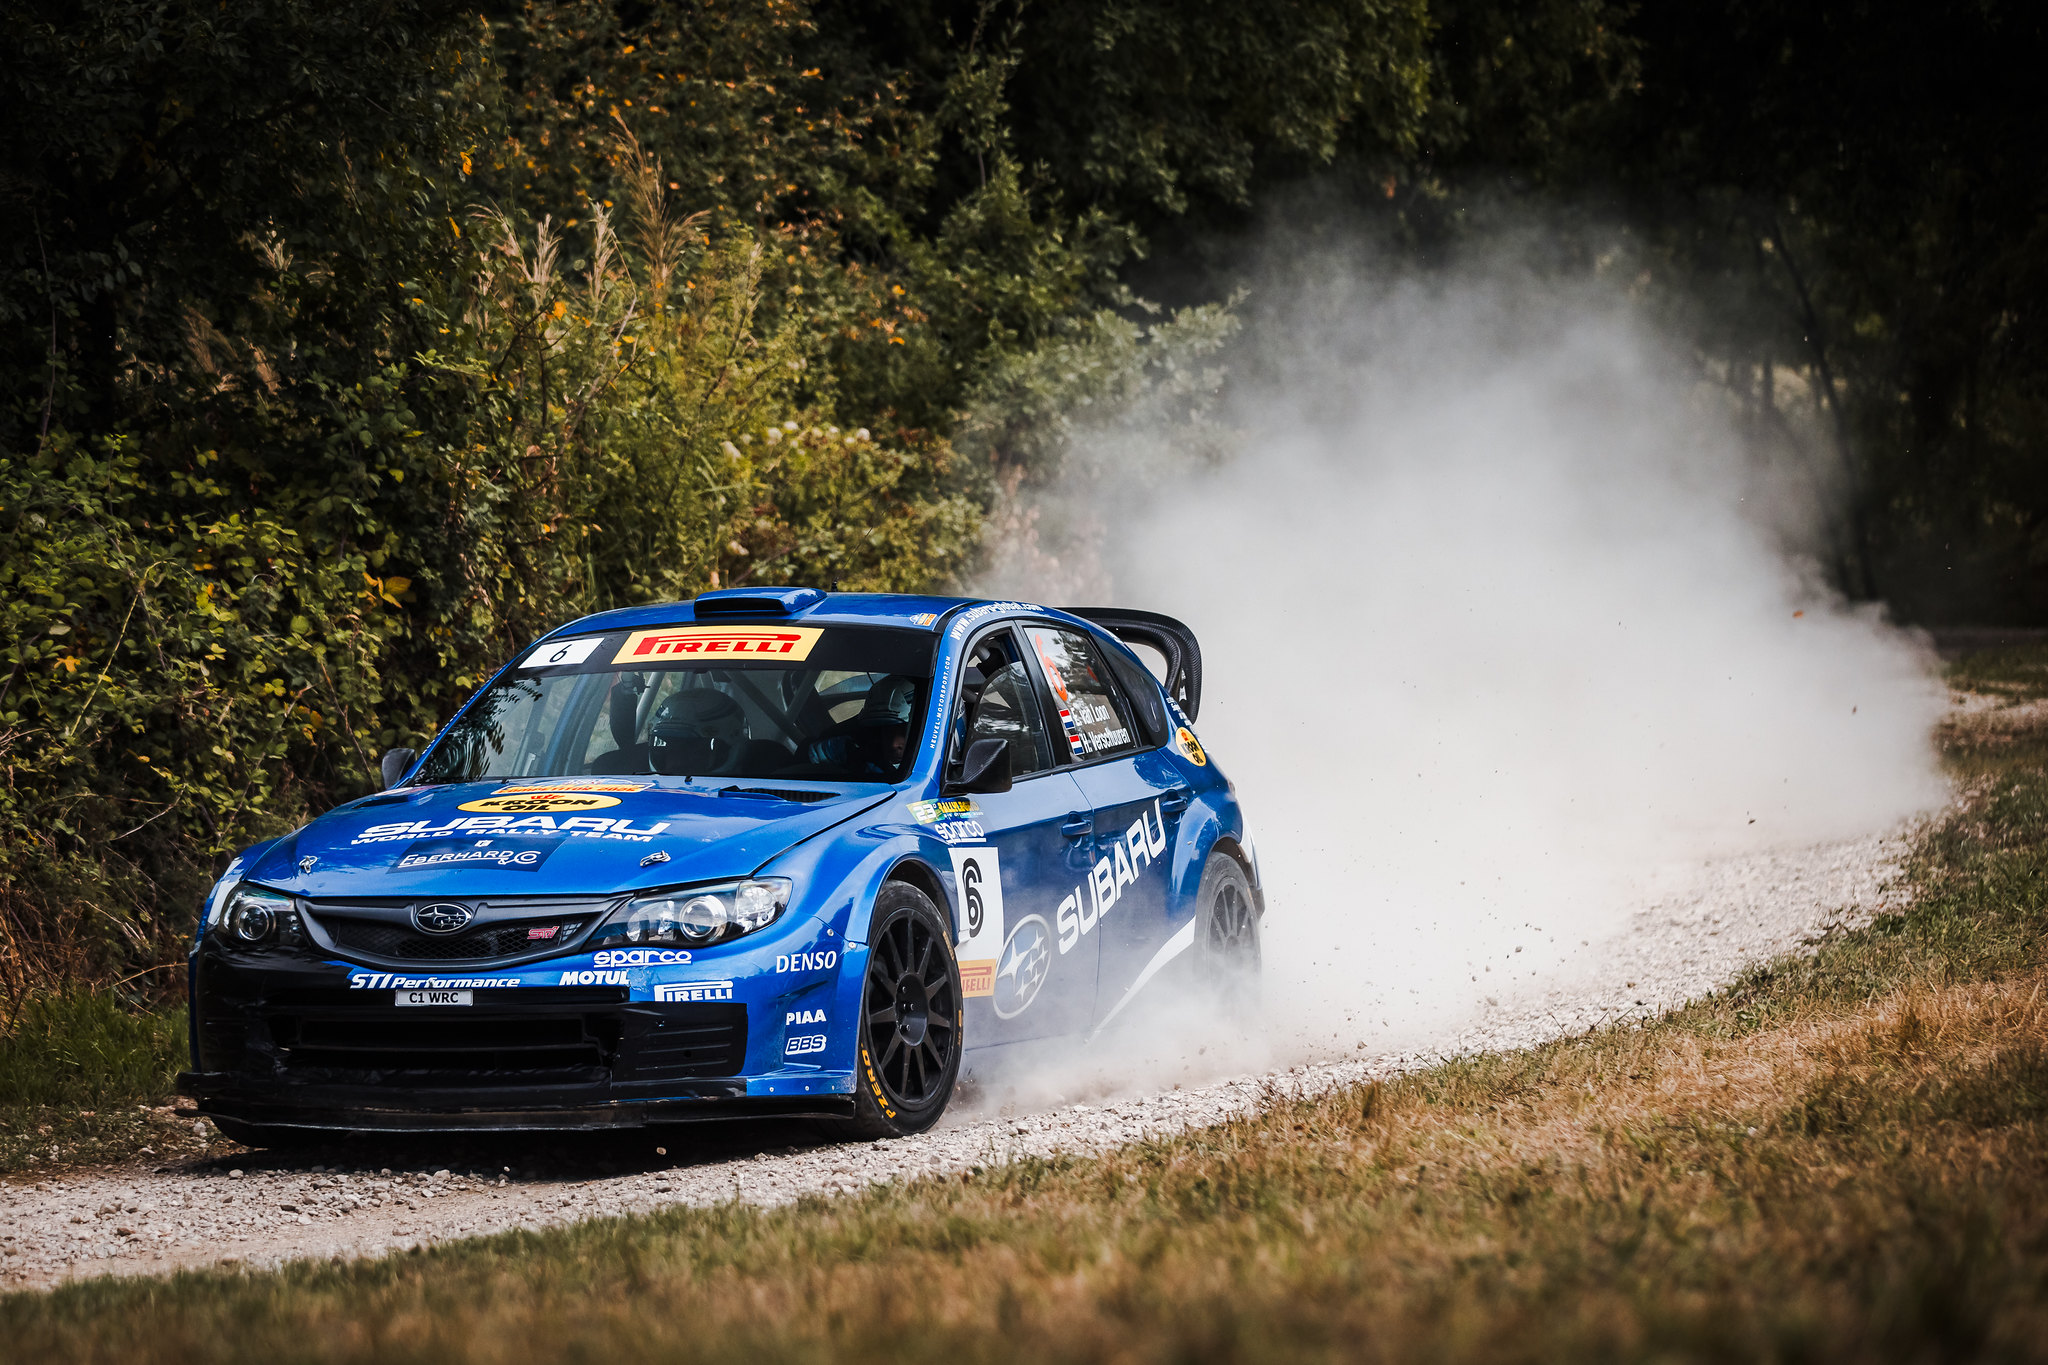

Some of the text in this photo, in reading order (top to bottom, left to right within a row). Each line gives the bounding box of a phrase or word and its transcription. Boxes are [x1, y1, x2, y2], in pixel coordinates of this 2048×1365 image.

[549, 644, 572, 663] 6
[633, 633, 802, 656] PIRELLI
[480, 799, 599, 807] KROON
[350, 828, 654, 845] WORLD RALLY TEAM
[364, 816, 671, 838] SUBARU
[935, 821, 986, 844] sparco
[398, 850, 514, 868] EBERHARD
[1057, 798, 1166, 955] SUBARU
[962, 857, 984, 938] 6
[593, 950, 692, 968] sparco
[776, 950, 838, 974] DENSO
[350, 974, 521, 989] STI Performance
[559, 970, 629, 986] MOTUL
[409, 992, 459, 1003] C1 WRC
[654, 981, 734, 1001] PIRELLI
[785, 1009, 827, 1025] PIAA
[785, 1034, 827, 1056] BBS
